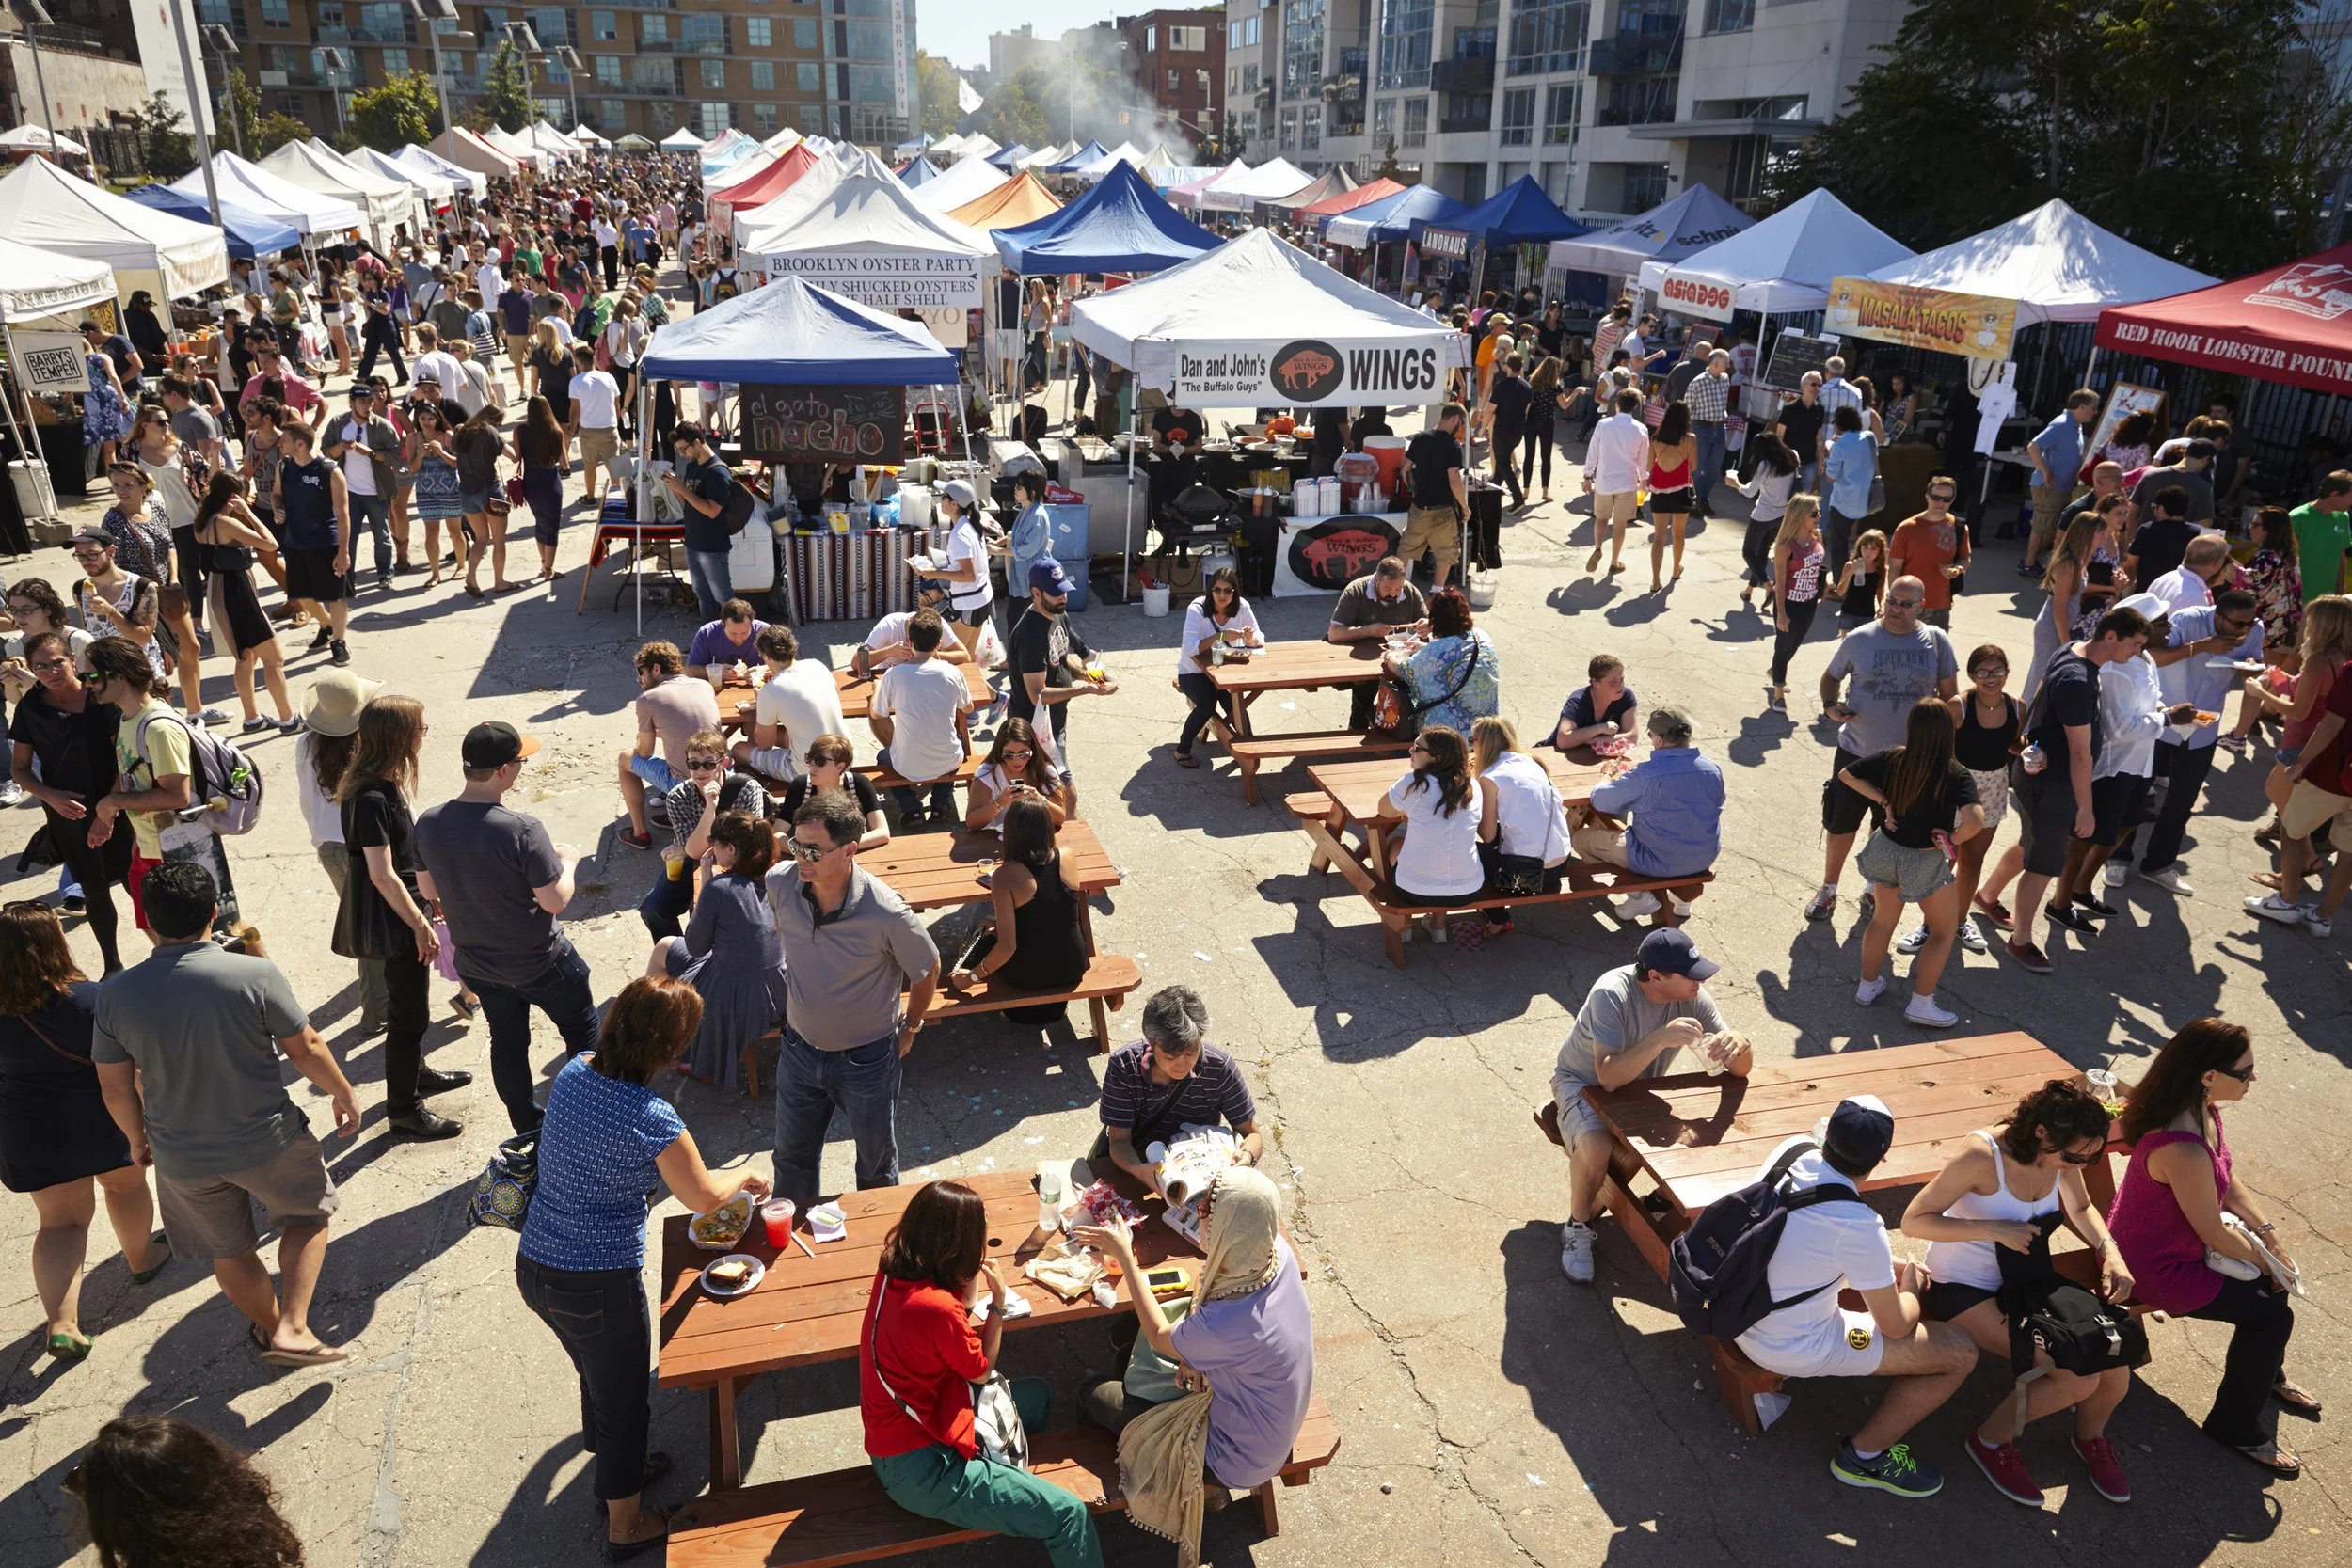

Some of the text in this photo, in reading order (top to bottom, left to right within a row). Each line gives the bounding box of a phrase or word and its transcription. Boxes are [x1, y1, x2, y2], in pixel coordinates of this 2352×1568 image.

[1422, 230, 1468, 256] LANDHAUS
[772, 257, 975, 272] BROOKLYN OYSTER PARTY
[842, 280, 911, 293] SHUCKED
[914, 280, 975, 293] OYSTERS
[864, 293, 900, 306] HALF
[904, 294, 948, 306] SHELL
[1858, 296, 1915, 332] MASALA
[1918, 308, 1967, 344] TACOS
[2115, 322, 2149, 343] RED
[2150, 329, 2202, 352] HOOK
[2202, 337, 2286, 368] LOBSTER
[28, 350, 72, 368] BARRY'S
[1182, 353, 1266, 377] Dan and John's
[1295, 362, 1327, 371] WINGS
[33, 362, 78, 380] TEMPEH
[1349, 348, 1436, 391] WINGS
[1182, 381, 1262, 392] "The Buffalo Guys"
[752, 392, 829, 420] el gato
[753, 409, 884, 455] nacho
[1327, 542, 1376, 554] WINGS
[1873, 649, 1902, 669] SUPER
